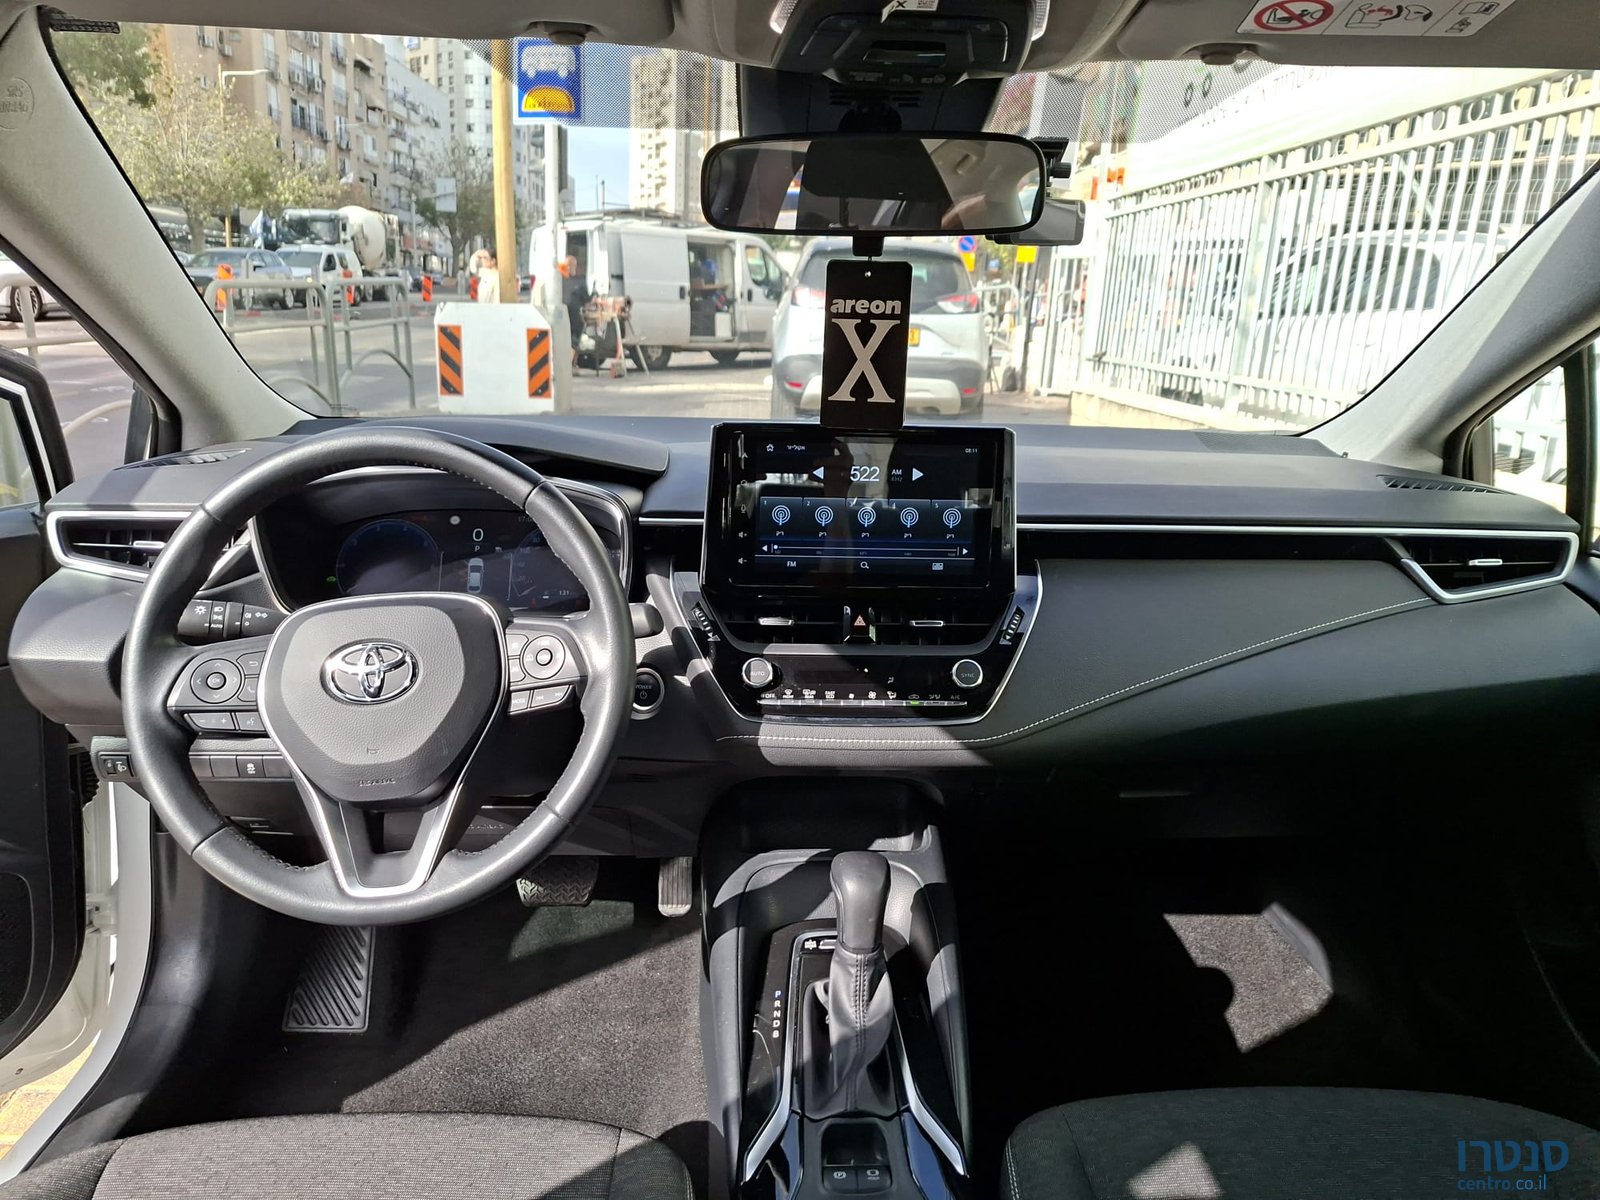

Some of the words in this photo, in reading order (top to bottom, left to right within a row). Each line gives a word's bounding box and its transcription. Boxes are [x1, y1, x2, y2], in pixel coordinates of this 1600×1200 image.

[830, 298, 902, 315] areon
[828, 318, 900, 403] X
[850, 465, 880, 482] 522
[775, 990, 782, 998] P
[774, 1000, 781, 1008] R
[773, 1010, 781, 1018] N
[772, 1019, 781, 1028] D
[772, 1030, 780, 1039] B
